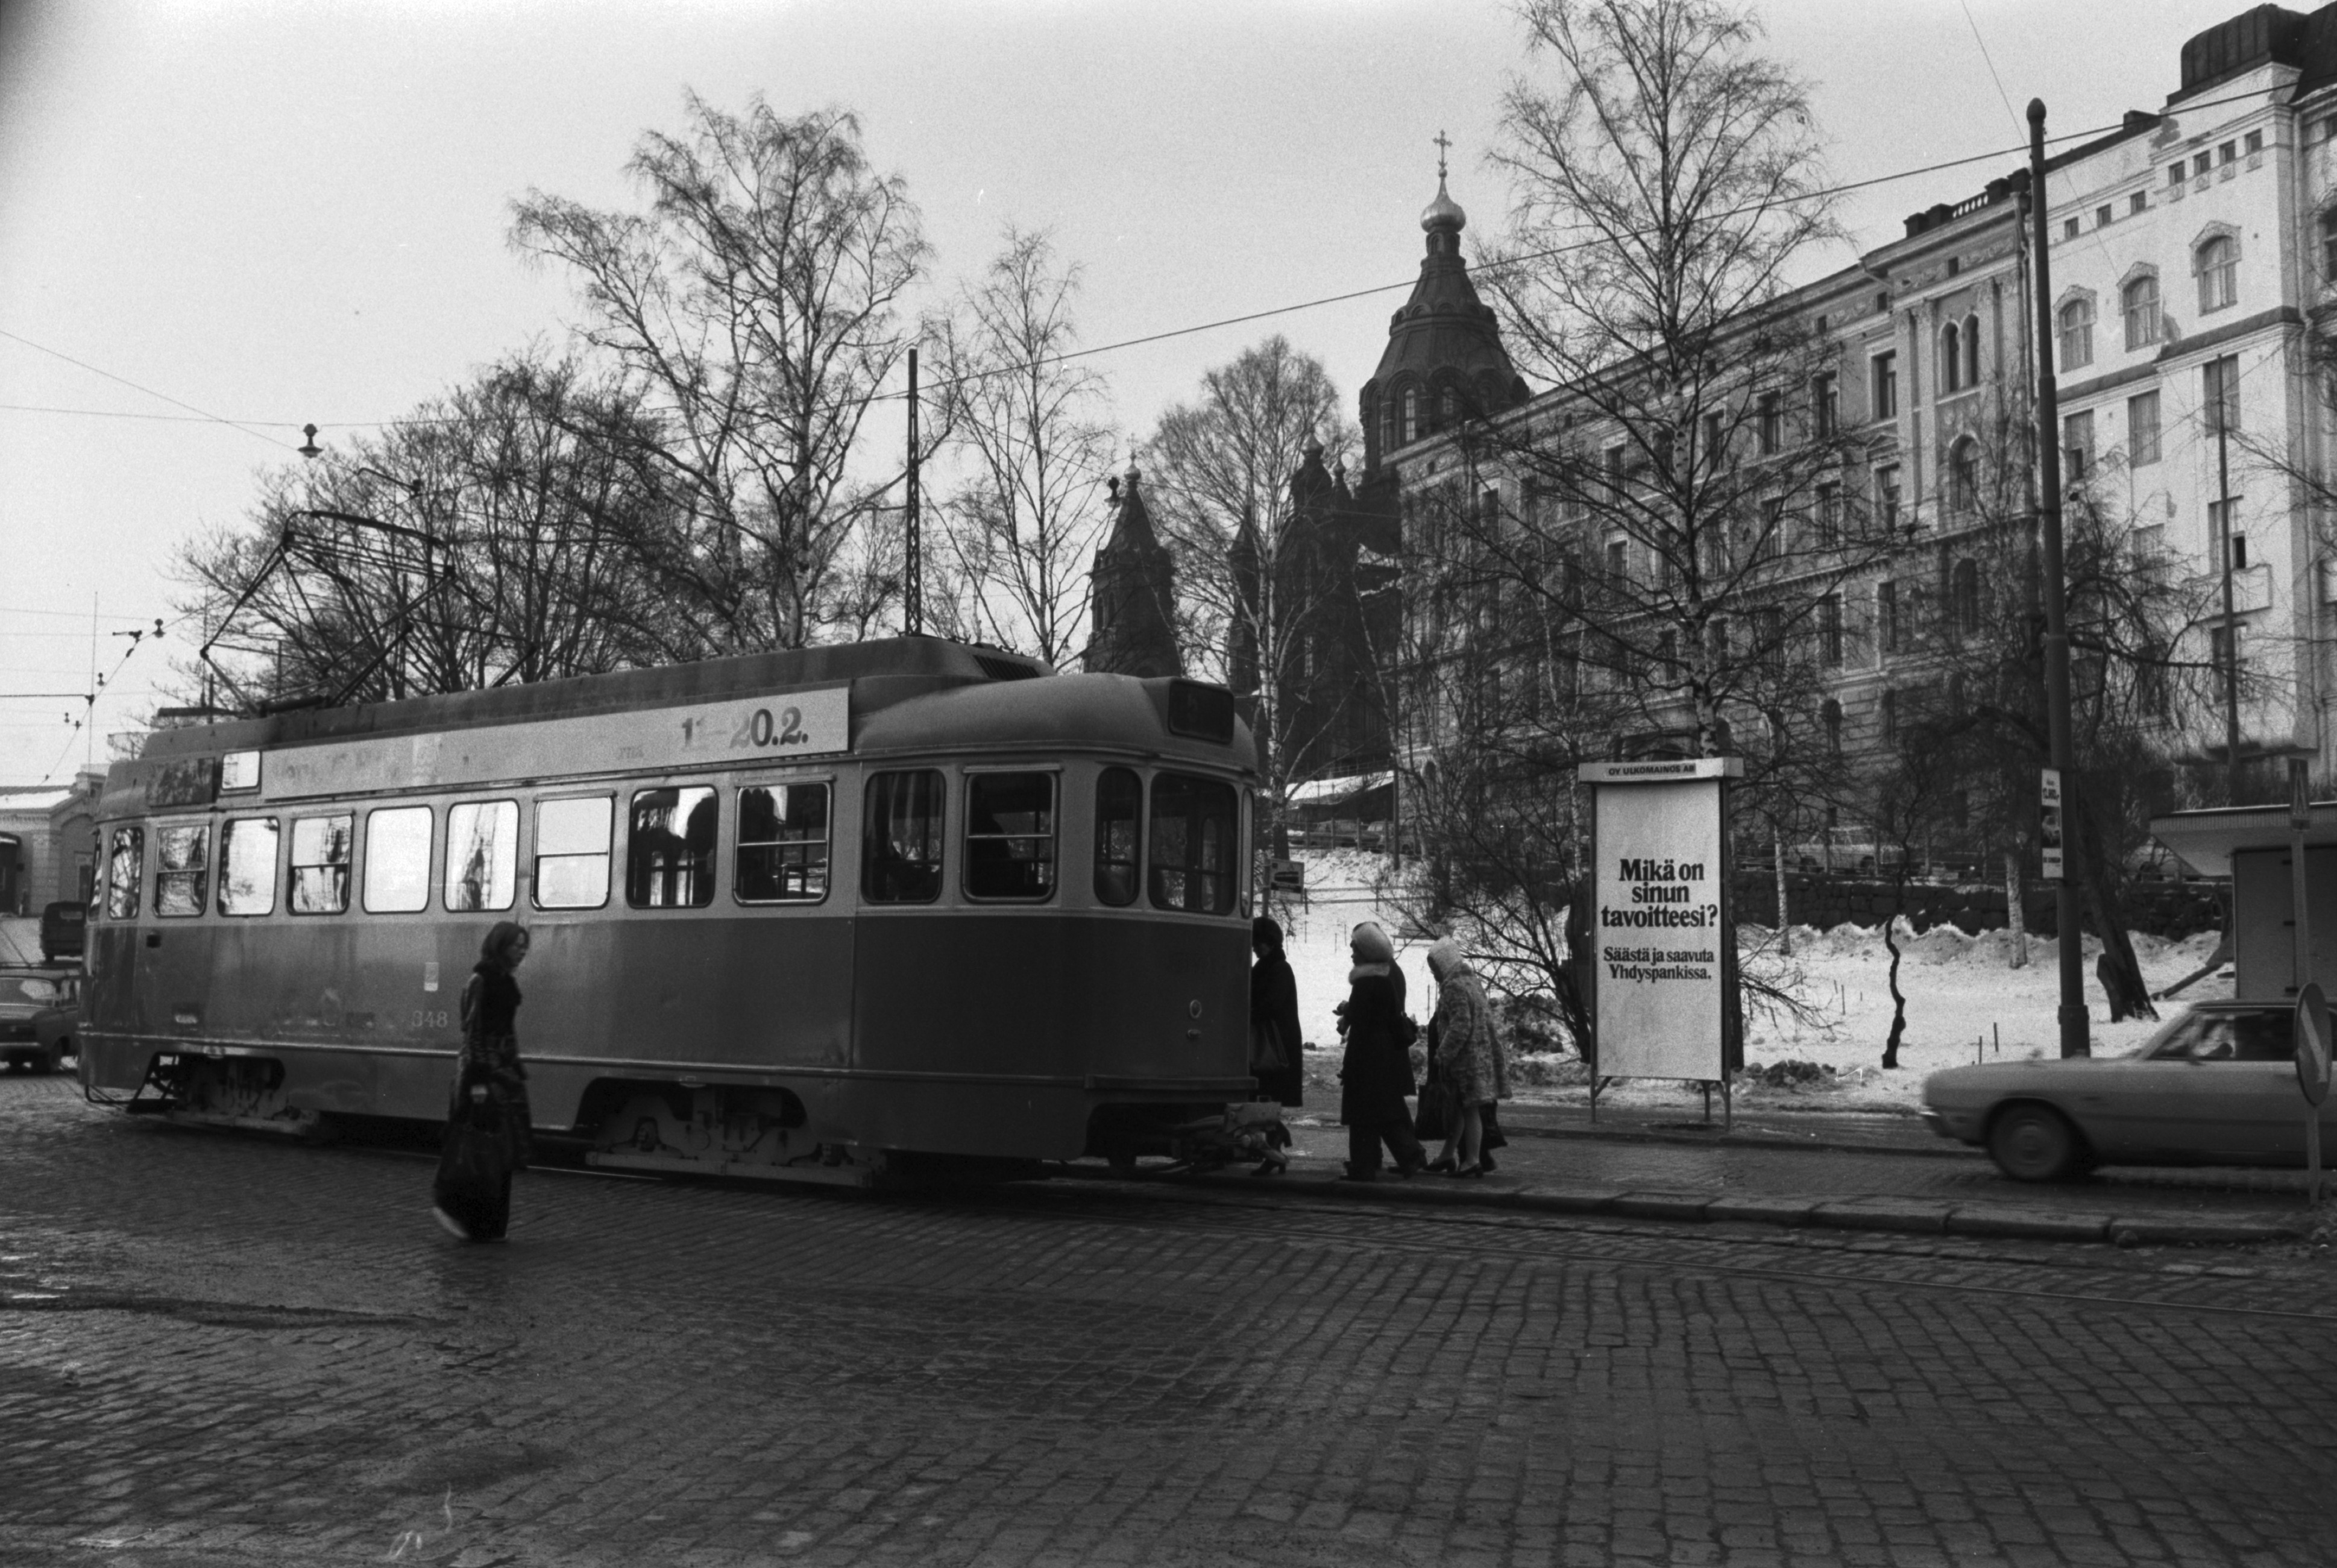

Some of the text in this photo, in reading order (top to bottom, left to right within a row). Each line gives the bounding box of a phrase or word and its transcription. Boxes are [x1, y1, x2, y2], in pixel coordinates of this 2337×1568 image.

[1609, 767, 1620, 776] OY
[1623, 765, 1681, 775] ULKOMAINOS
[1619, 858, 1704, 881] Mikä on
[1632, 881, 1690, 904] sinun
[1601, 904, 1719, 927] tavoitteesi?
[1603, 946, 1714, 966] Säästä ja saavuta
[1609, 963, 1712, 983] Yhdyspankissa.
[411, 1010, 448, 1028] 348
